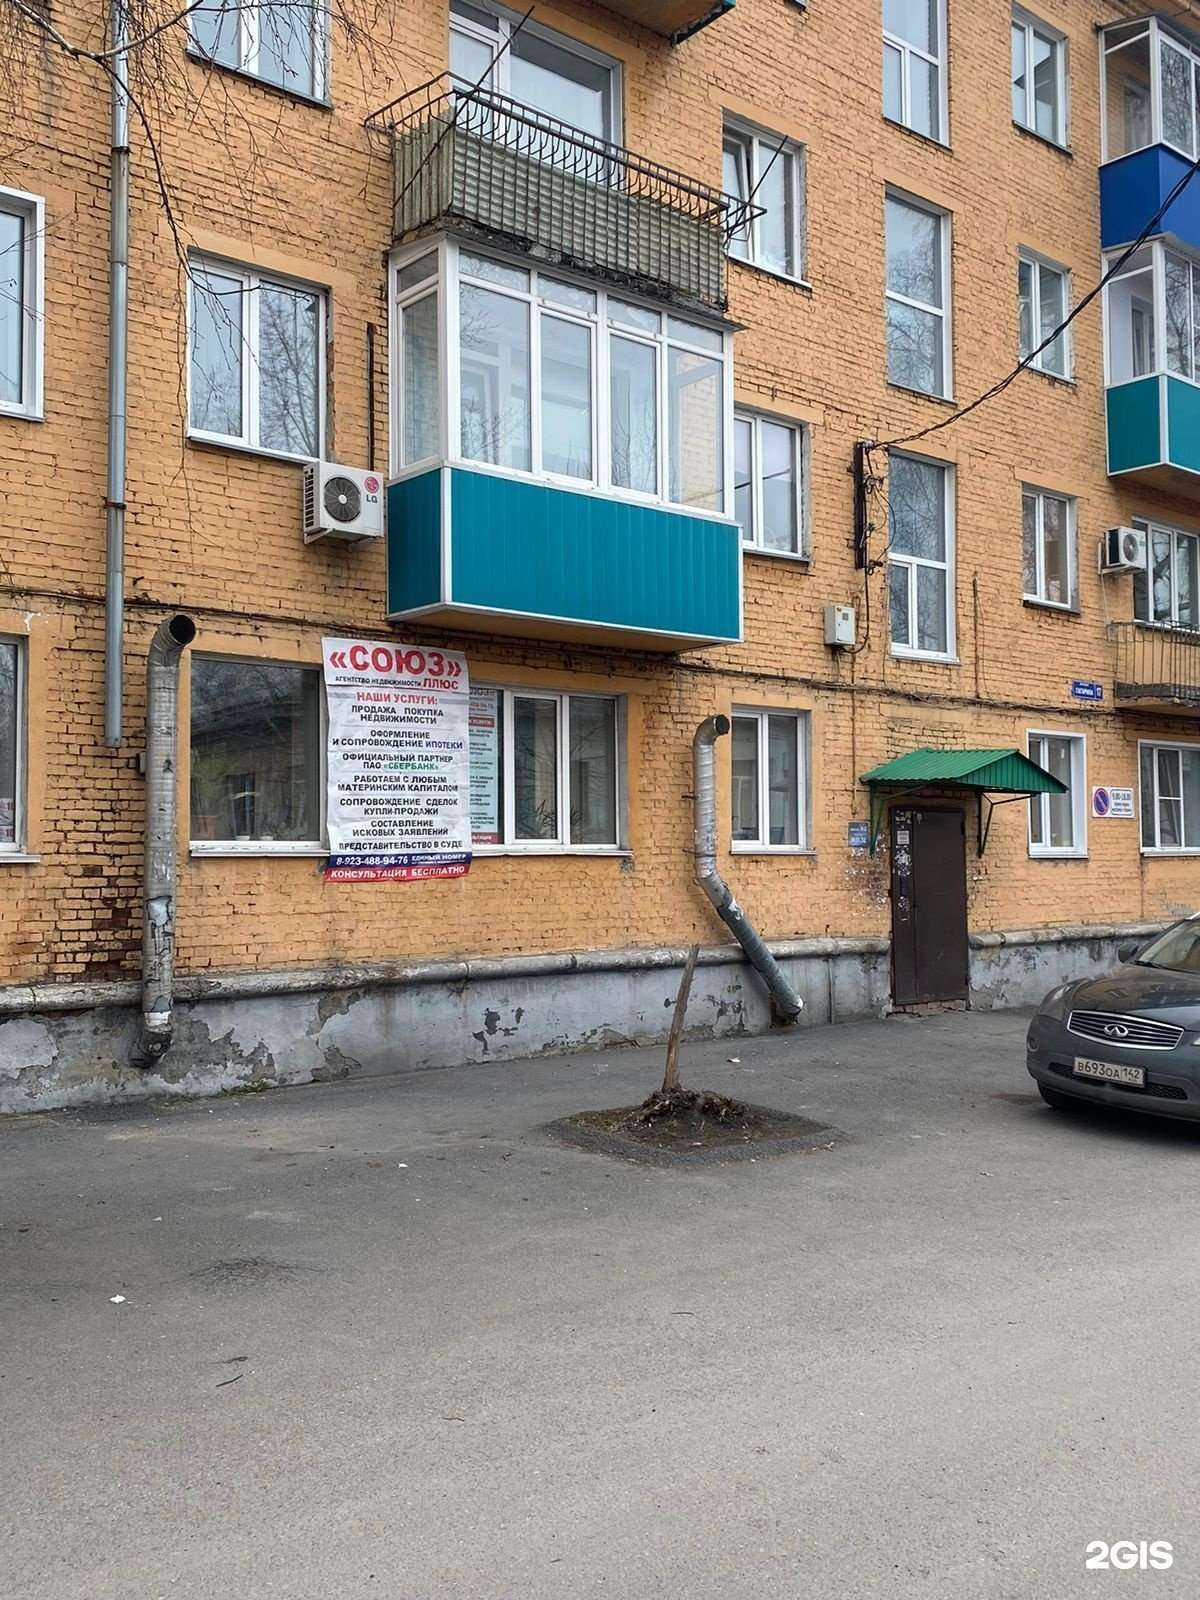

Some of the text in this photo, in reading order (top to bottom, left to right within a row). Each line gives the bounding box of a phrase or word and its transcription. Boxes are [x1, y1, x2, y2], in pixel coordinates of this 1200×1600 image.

[366, 494, 378, 504] LG
[329, 645, 462, 677] «СОЮЗ»
[335, 676, 421, 687] АГЕНТСТВО НЕДВИЖИМОСТИ
[423, 678, 459, 690] ПЛЮС
[356, 691, 438, 705] НАШИ УСЛУГИ:
[351, 705, 444, 717] ПРОДАЖА ПОКУПКА
[360, 714, 437, 725] НЕДВИЖИМОСТИ
[370, 729, 430, 739] ОФОРМЛЕНИЕ
[332, 738, 340, 746] И
[341, 738, 423, 748] СОПРОВОЖДЕНИЕ
[425, 741, 463, 750] ИПОТЕКИ
[342, 752, 453, 763] ОФИЦИАЛЬНЫЙ ПАРТНЕР
[363, 761, 439, 771] ПАО «СБЕРБАНК»
[353, 775, 447, 784] РАБОТАЕМ С ЛЮБЫМ
[337, 783, 458, 793] МАТЕРИНСКИМ КАПИТАЛОМ
[339, 798, 458, 808] СОПРОВОЖДЕНИЕ СДЕЛОК
[363, 807, 439, 816] КУПЛИ-ПРОДАЖИ
[370, 819, 434, 828] СОСТАВЛЕНИЕ
[352, 828, 449, 837] ИСКОВЫХ ЗАЯВЛЕНИЙ
[339, 840, 463, 850] ПРЕДСТАВИТЕЛЬСТВО В СУДЕ
[336, 855, 408, 866] 8-923-488-94-76
[331, 865, 465, 879] КОНСУЛЬТАЦИЯ БЕСПЛАТНО
[1123, 1068, 1140, 1080] 142
